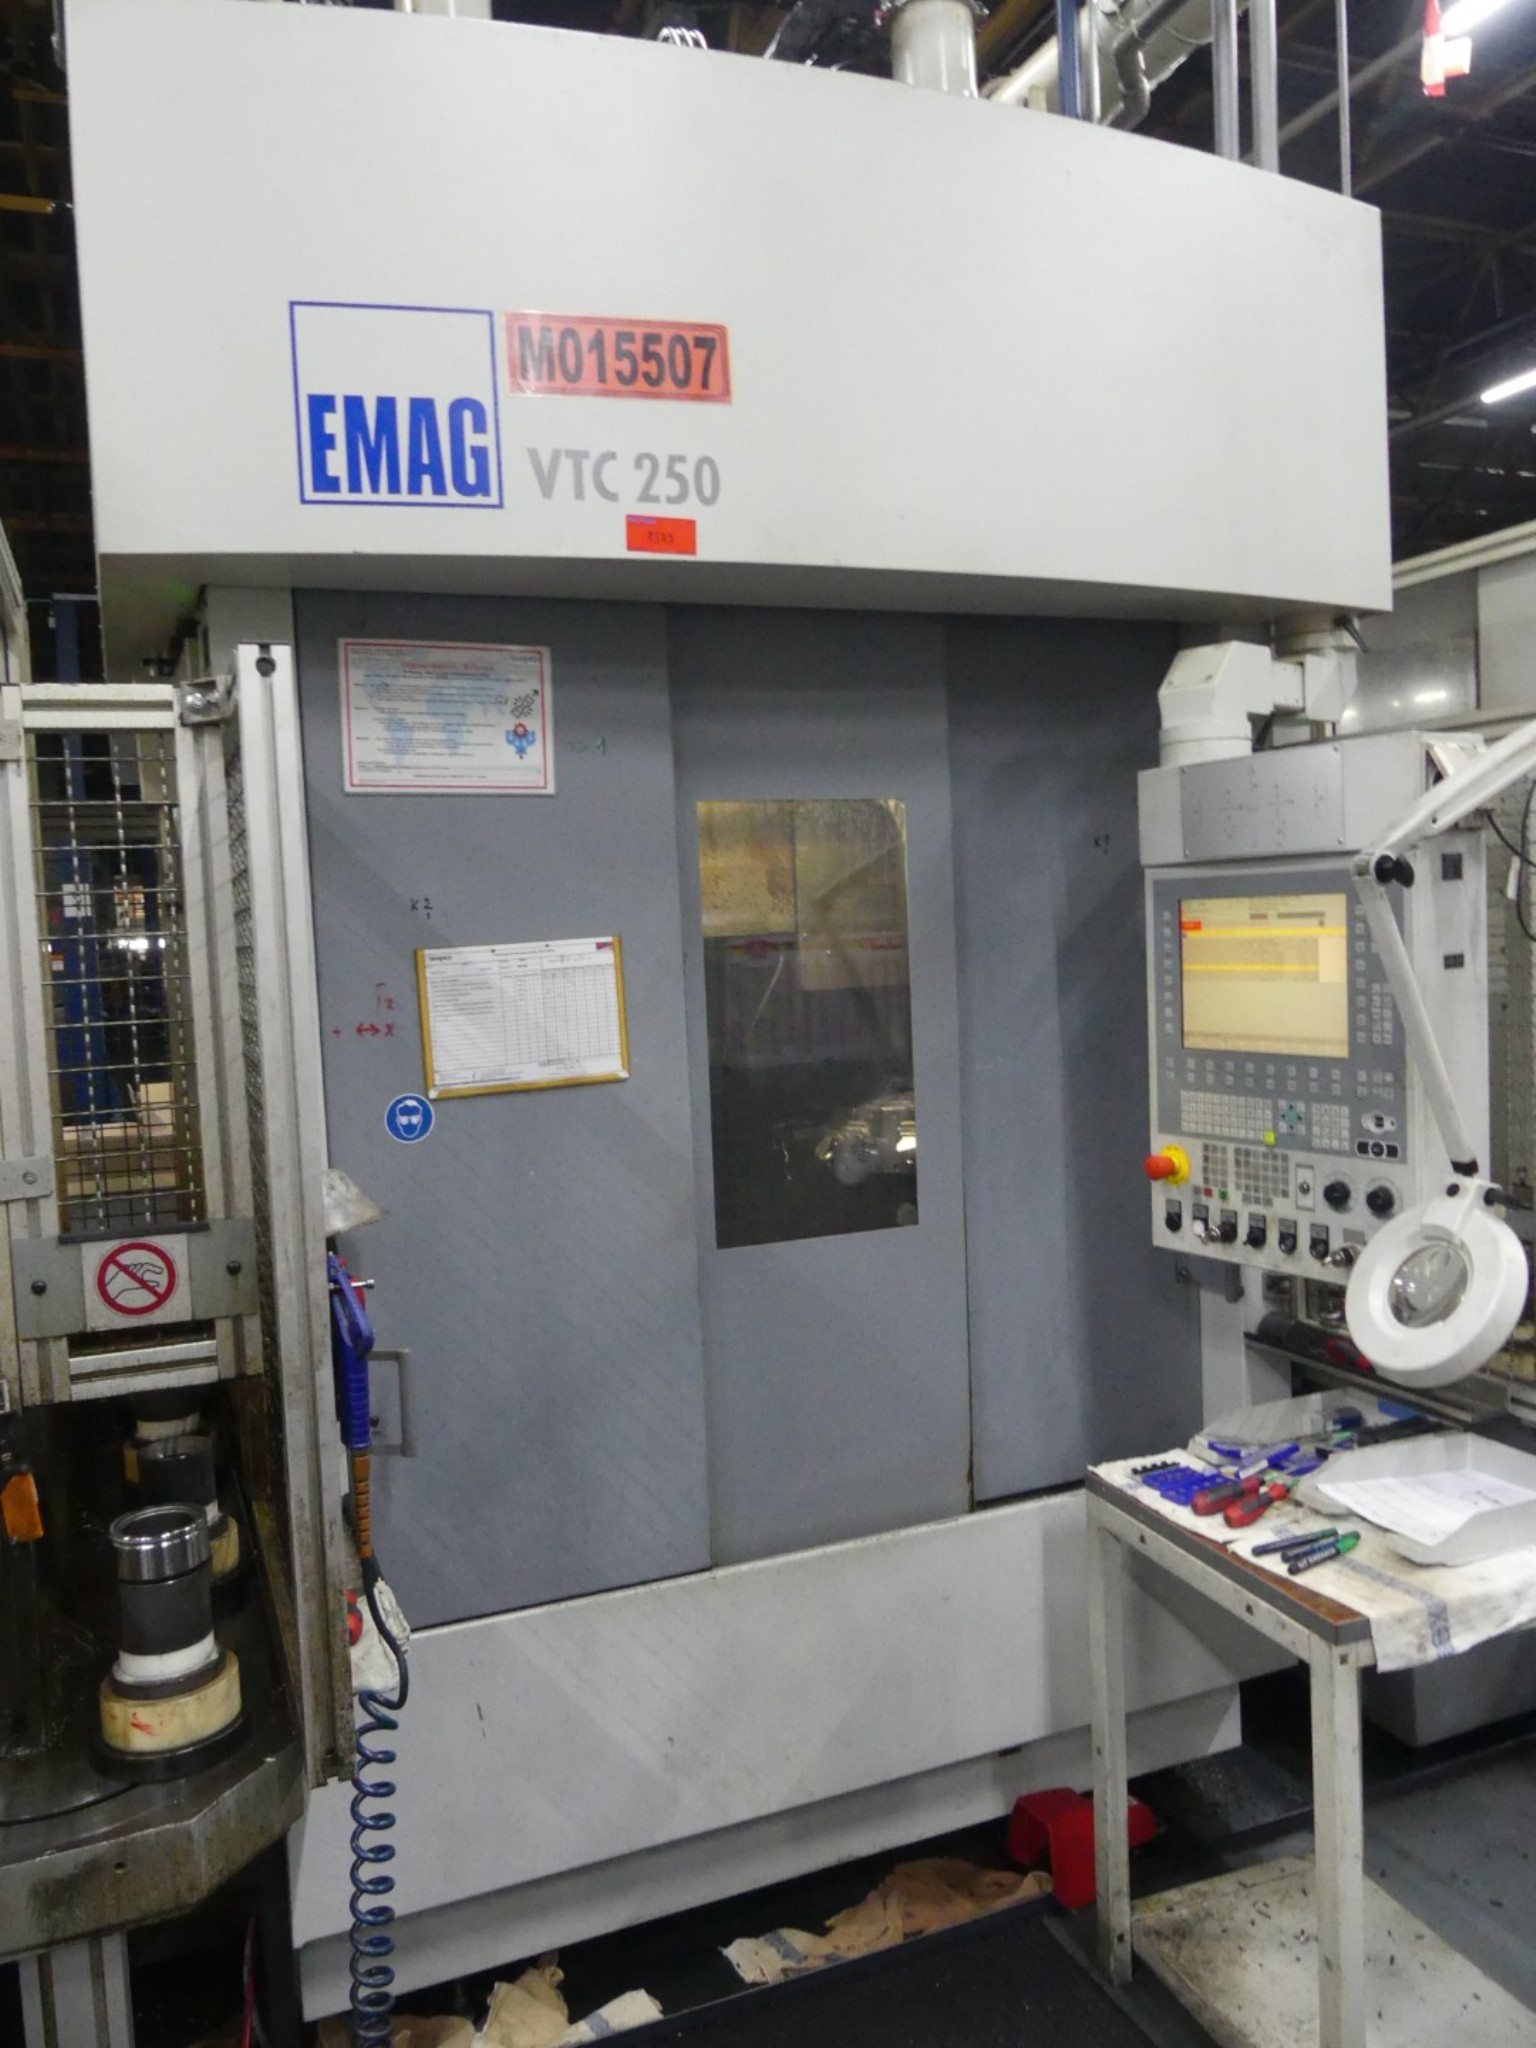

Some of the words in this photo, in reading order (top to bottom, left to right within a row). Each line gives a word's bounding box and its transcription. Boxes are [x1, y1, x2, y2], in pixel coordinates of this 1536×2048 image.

[517, 326, 718, 391] M015507
[306, 393, 492, 498] EMAG
[526, 447, 620, 504] VTC
[633, 452, 721, 507] 250
